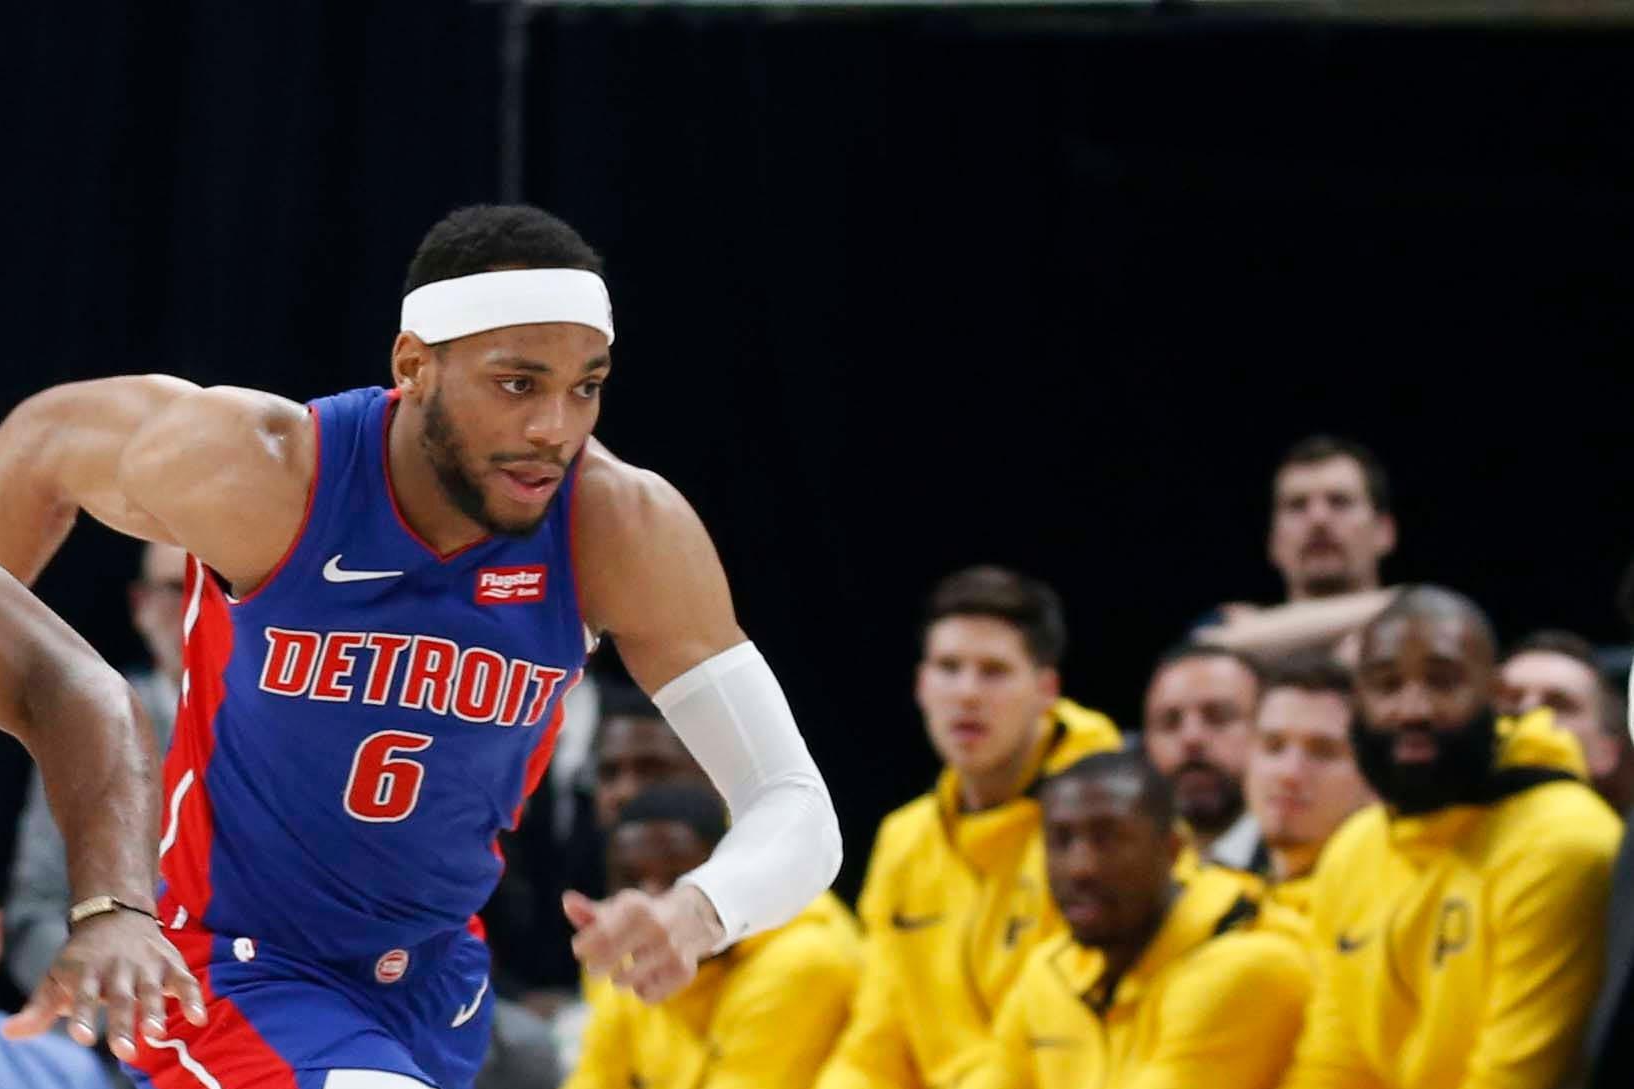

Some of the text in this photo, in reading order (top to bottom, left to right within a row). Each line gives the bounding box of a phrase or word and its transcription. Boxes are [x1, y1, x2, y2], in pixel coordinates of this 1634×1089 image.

[480, 571, 542, 589] Flagstar
[258, 627, 567, 727] DETROIT
[343, 729, 434, 823] 6
